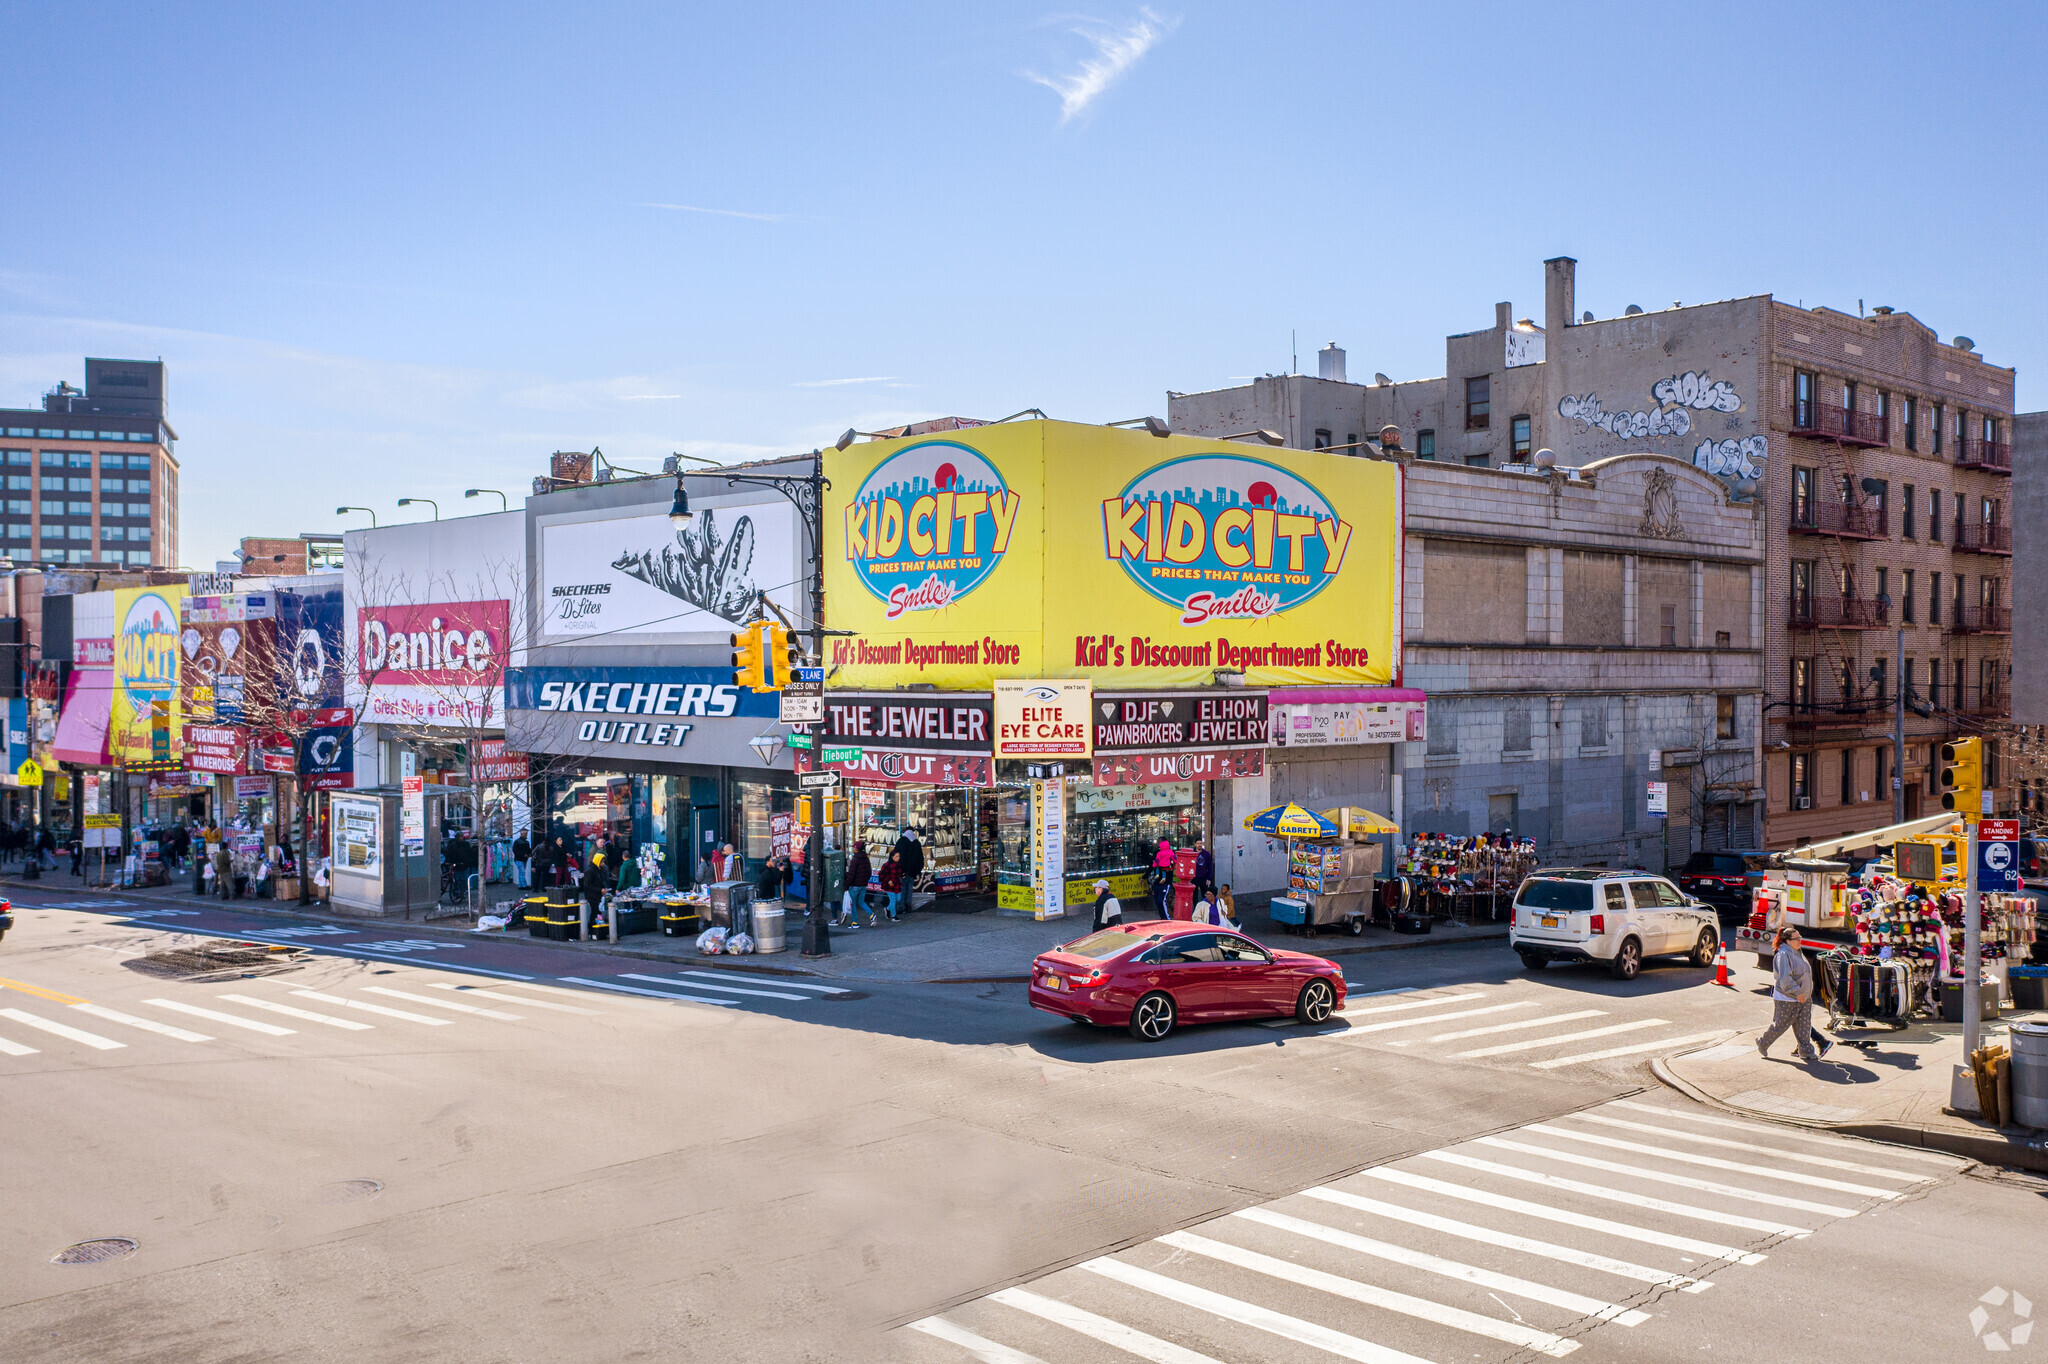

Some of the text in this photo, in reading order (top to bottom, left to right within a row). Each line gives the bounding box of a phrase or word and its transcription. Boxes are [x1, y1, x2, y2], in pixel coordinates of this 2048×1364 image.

[845, 489, 1020, 561] KID CITY
[1104, 497, 1353, 574] KID CITY
[868, 558, 981, 574] PRICES THAT MAKE YOU
[188, 573, 234, 595] WIRELESS
[1151, 567, 1310, 585] PRICES THAT MAKE YOU
[551, 583, 612, 597] SKECHERS
[559, 597, 602, 619] D'Lites
[568, 621, 598, 630] ORIGINAL
[364, 617, 492, 671] Danice
[117, 632, 181, 681] KID CITY
[832, 636, 1020, 671] Kid's Discount Department Store
[1075, 635, 1368, 673] Kid's Discount Department Store
[806, 671, 821, 680] LANE
[785, 682, 820, 690] BUSES ONLY
[538, 681, 741, 717] SKECHERS
[374, 699, 399, 714] Great
[401, 698, 424, 719] Style
[438, 700, 464, 718] Great
[1022, 707, 1062, 721] ELITE
[1125, 701, 1158, 722] DJF
[1201, 700, 1258, 720] ELHOM
[1334, 711, 1350, 719] PAY
[830, 705, 873, 735] THE
[876, 707, 986, 741] JEWELER
[1001, 724, 1084, 738] EYE CARE
[1190, 720, 1267, 742] JEWELRY
[1335, 719, 1358, 737] GO
[192, 728, 235, 745] FURNITURE
[578, 720, 692, 746] OUTLET
[1098, 722, 1183, 745] PAWNBROKERS
[203, 745, 230, 755] ELECTRONIC
[825, 749, 852, 760] Tiebout
[193, 755, 236, 771] WAREHOUSE
[1280, 826, 1318, 834] SABRETT
[945, 876, 966, 884] REPAIR
[2004, 870, 2017, 880] 62
